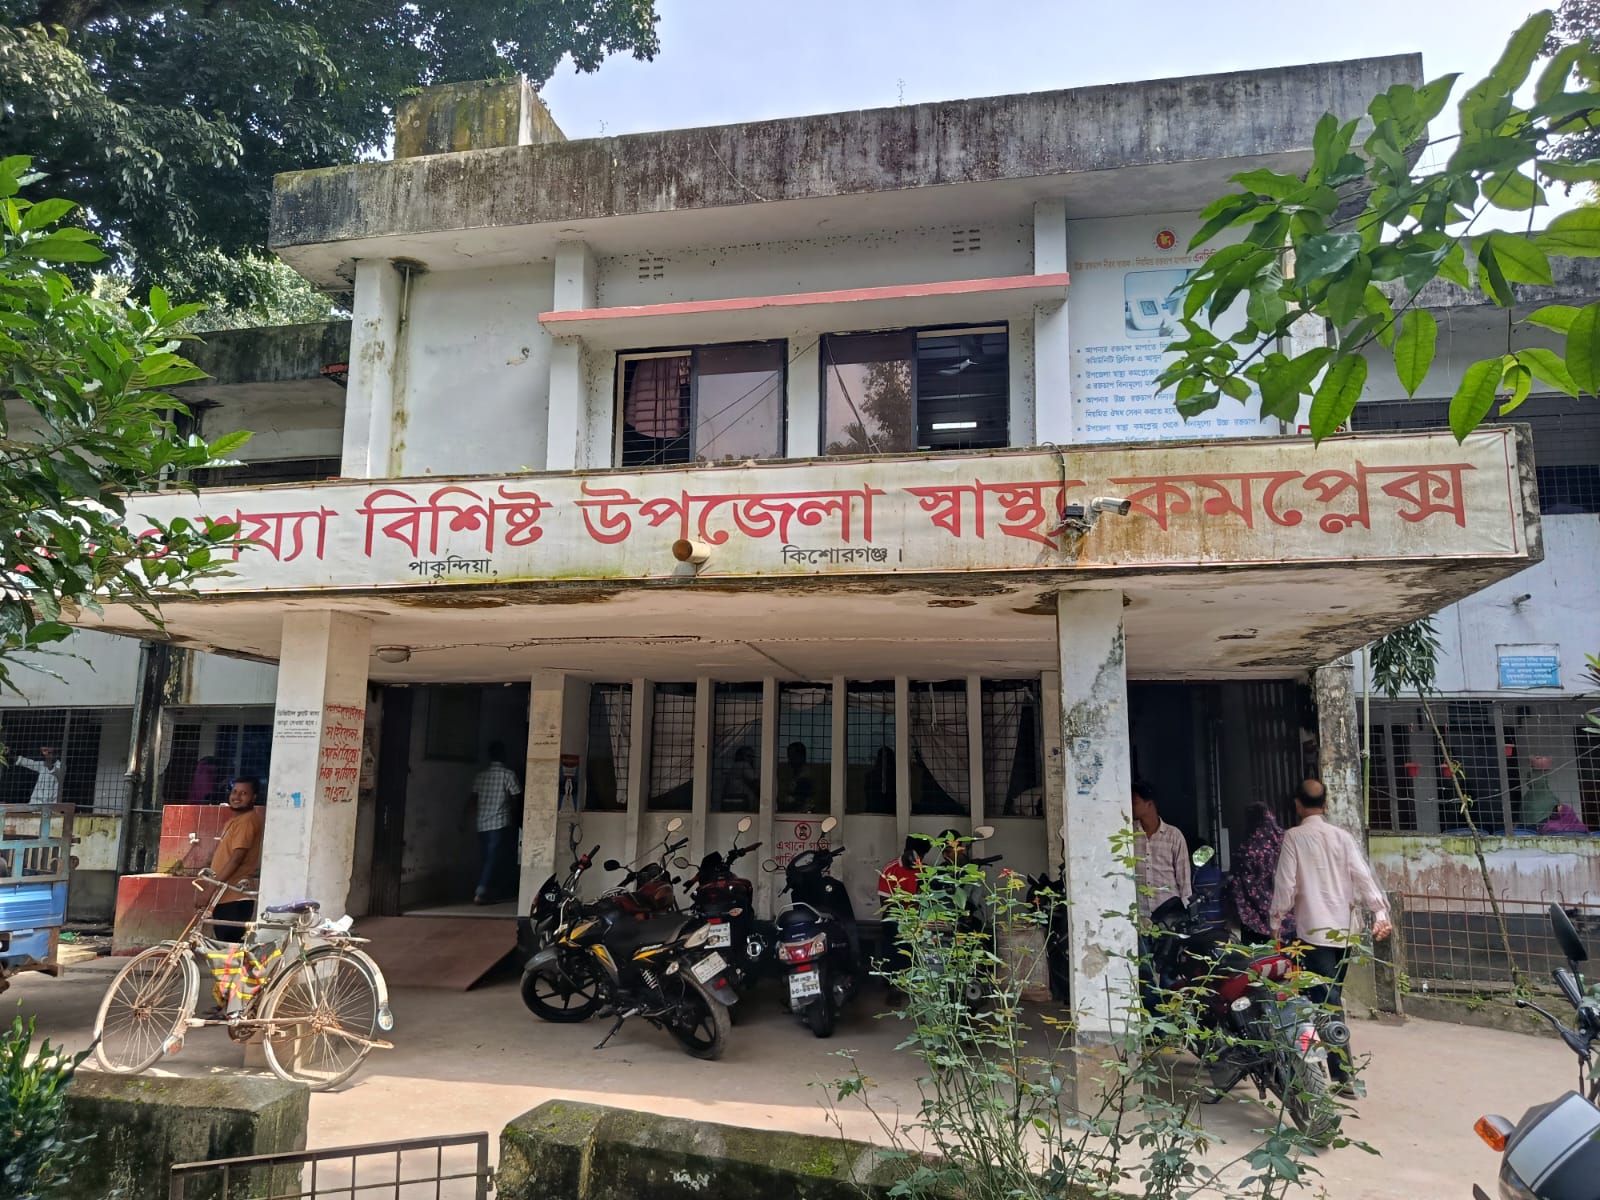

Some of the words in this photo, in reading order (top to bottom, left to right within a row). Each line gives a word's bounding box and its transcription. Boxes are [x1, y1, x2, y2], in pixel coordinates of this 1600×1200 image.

[356, 484, 552, 559] বিশিষ্ট
[574, 480, 887, 545] উপজেলা
[1109, 460, 1478, 534] কমপ্লেক্স
